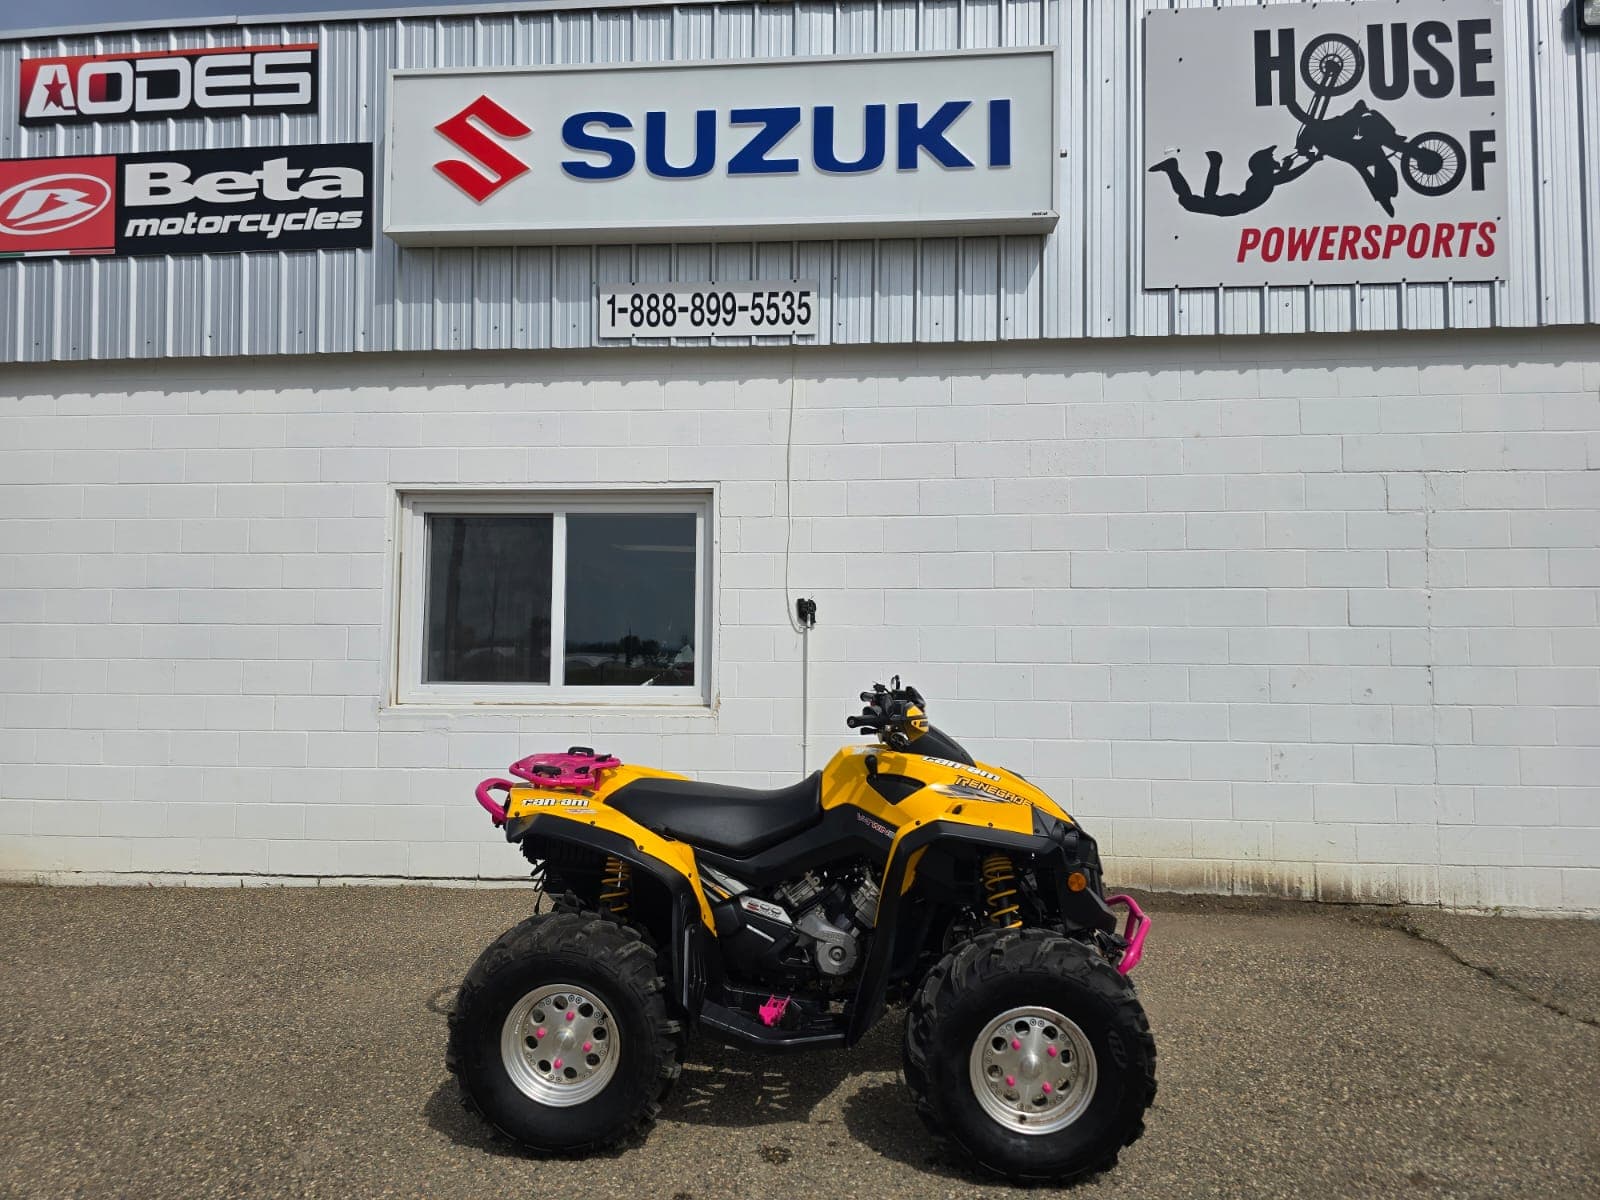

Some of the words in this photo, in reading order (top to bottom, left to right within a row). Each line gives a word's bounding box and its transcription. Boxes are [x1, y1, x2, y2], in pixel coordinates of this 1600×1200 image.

[25, 51, 312, 118] AODES
[1254, 18, 1496, 107] HOUSE
[560, 98, 1012, 181] SUZUKI
[124, 157, 364, 207] Beta
[124, 207, 363, 239] motorcycles
[1236, 221, 1498, 263] POWERSPORTS
[606, 291, 812, 327] 1-888-899-5535
[954, 774, 1034, 807] RENEGADE
